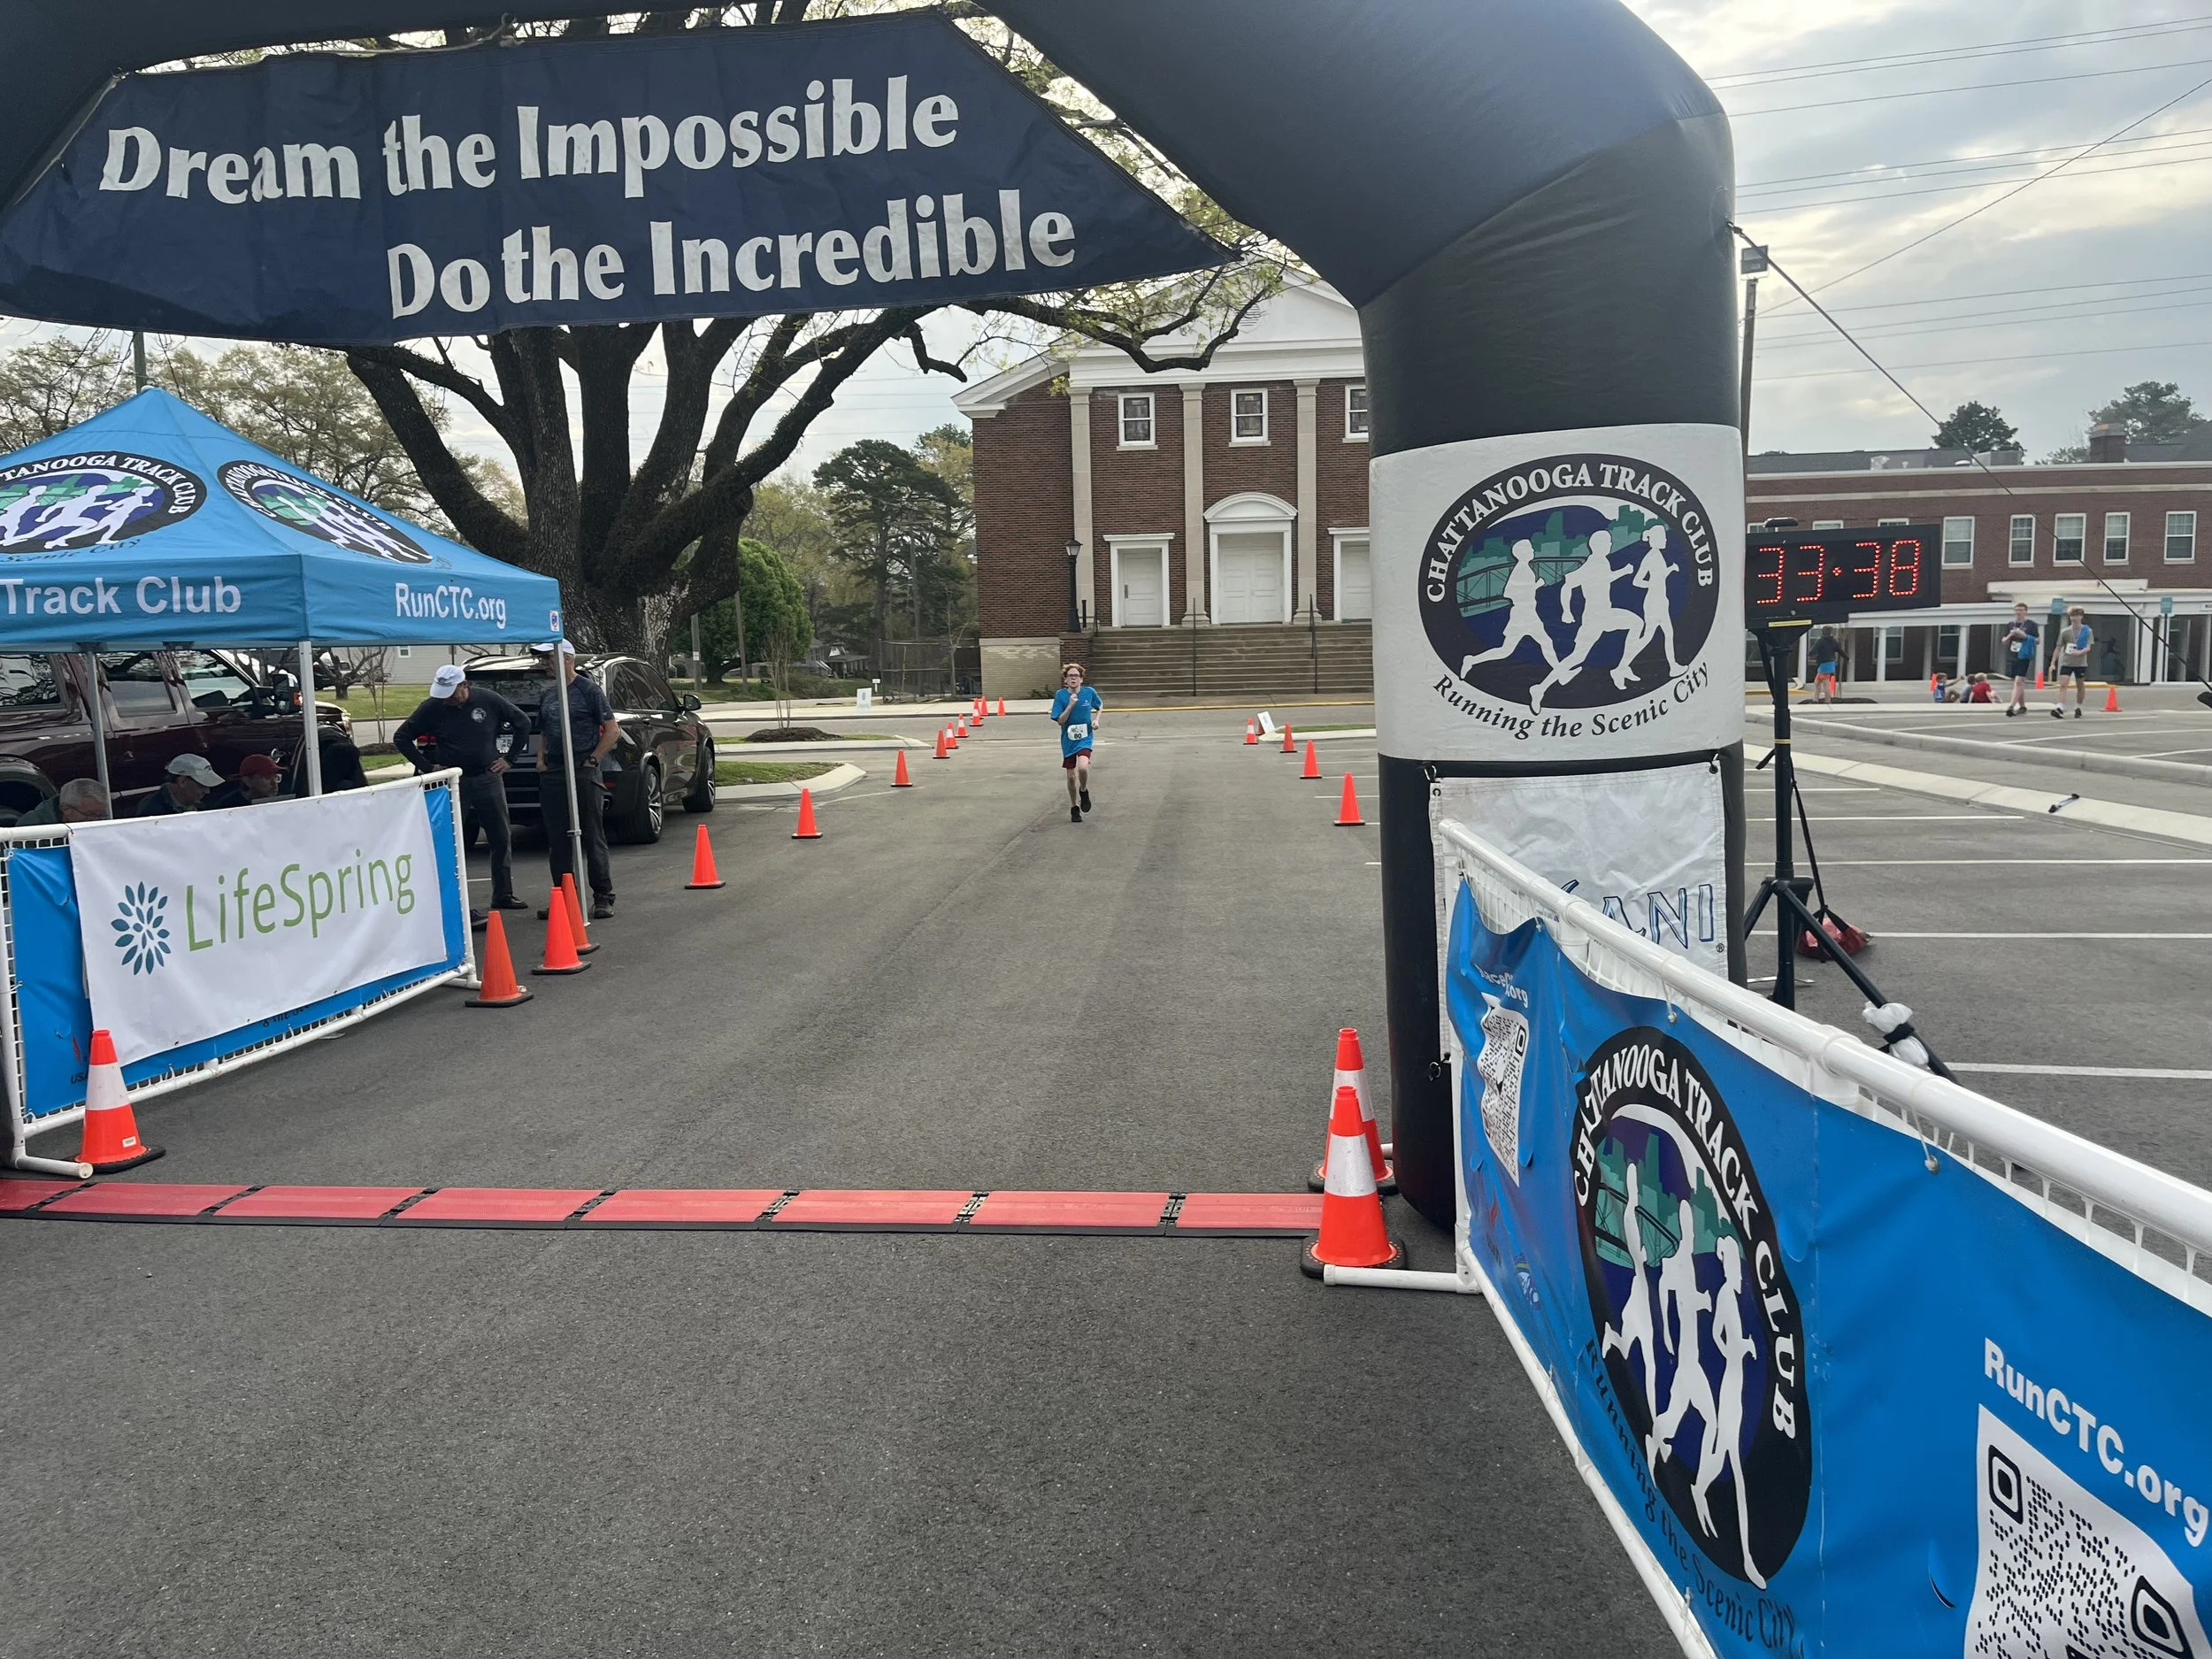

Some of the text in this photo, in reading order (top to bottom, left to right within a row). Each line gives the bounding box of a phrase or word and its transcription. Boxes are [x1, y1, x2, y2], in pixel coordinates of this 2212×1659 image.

[99, 74, 958, 204] Dream the Impossible
[387, 189, 1076, 319] Do the Incredible
[119, 457, 187, 486] TRACK
[168, 479, 196, 514] CLUB
[1425, 462, 1714, 603] CHATTANOOGA TRACK CLUB
[0, 576, 241, 615] Track Club
[88, 537, 141, 554] City
[396, 582, 507, 629] RunCTC.org
[1432, 661, 1709, 741] Running the Scenic City
[185, 848, 416, 952] LifeSpring
[1685, 1069, 1759, 1240] TRACK
[1755, 1240, 1796, 1440] CLUB
[1586, 1340, 1655, 1524] Running
[1661, 1512, 1689, 1571] the
[1692, 1553, 1754, 1643] Scenic
[1984, 1337, 2209, 1548] RunCTC.org
